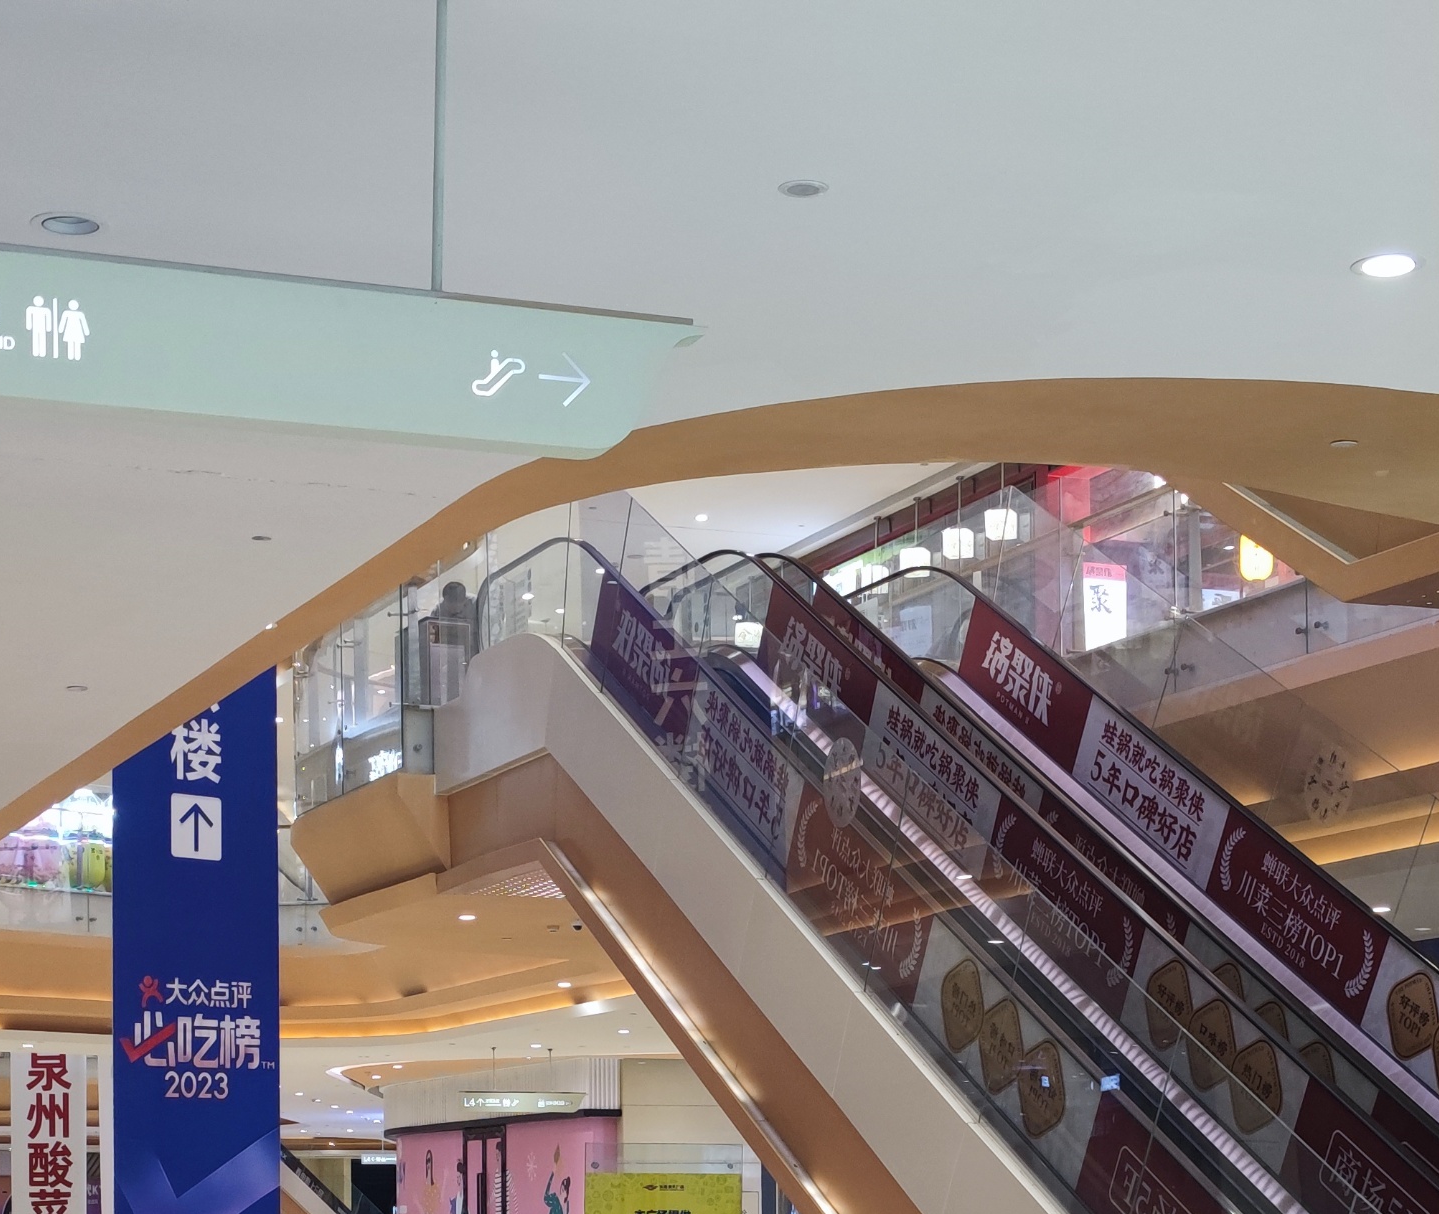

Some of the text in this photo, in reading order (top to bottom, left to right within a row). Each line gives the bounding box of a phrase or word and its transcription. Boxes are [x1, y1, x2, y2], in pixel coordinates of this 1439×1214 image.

[779, 615, 844, 704] 锅聚侠
[981, 630, 1055, 728] 锅聚侠
[170, 703, 223, 785] 楼
[886, 704, 981, 810] 蛙锅就吃锅聚侠
[1101, 719, 1206, 824] 蛙锅就吃锅聚侠
[1088, 748, 1198, 864] 5年口碑好店
[1030, 835, 1105, 918] 蝉联大众点评
[1261, 850, 1343, 932] 蝉联大众点评
[1235, 869, 1345, 981] 川菜三榜TOP1
[1260, 923, 1307, 969] ESTD 2018
[165, 978, 253, 1010] 大众点评
[1398, 993, 1430, 1028] 好评榜
[1398, 1012, 1423, 1038] TOP1
[121, 1012, 262, 1071] 必吃榜
[163, 1070, 230, 1101] 2023
